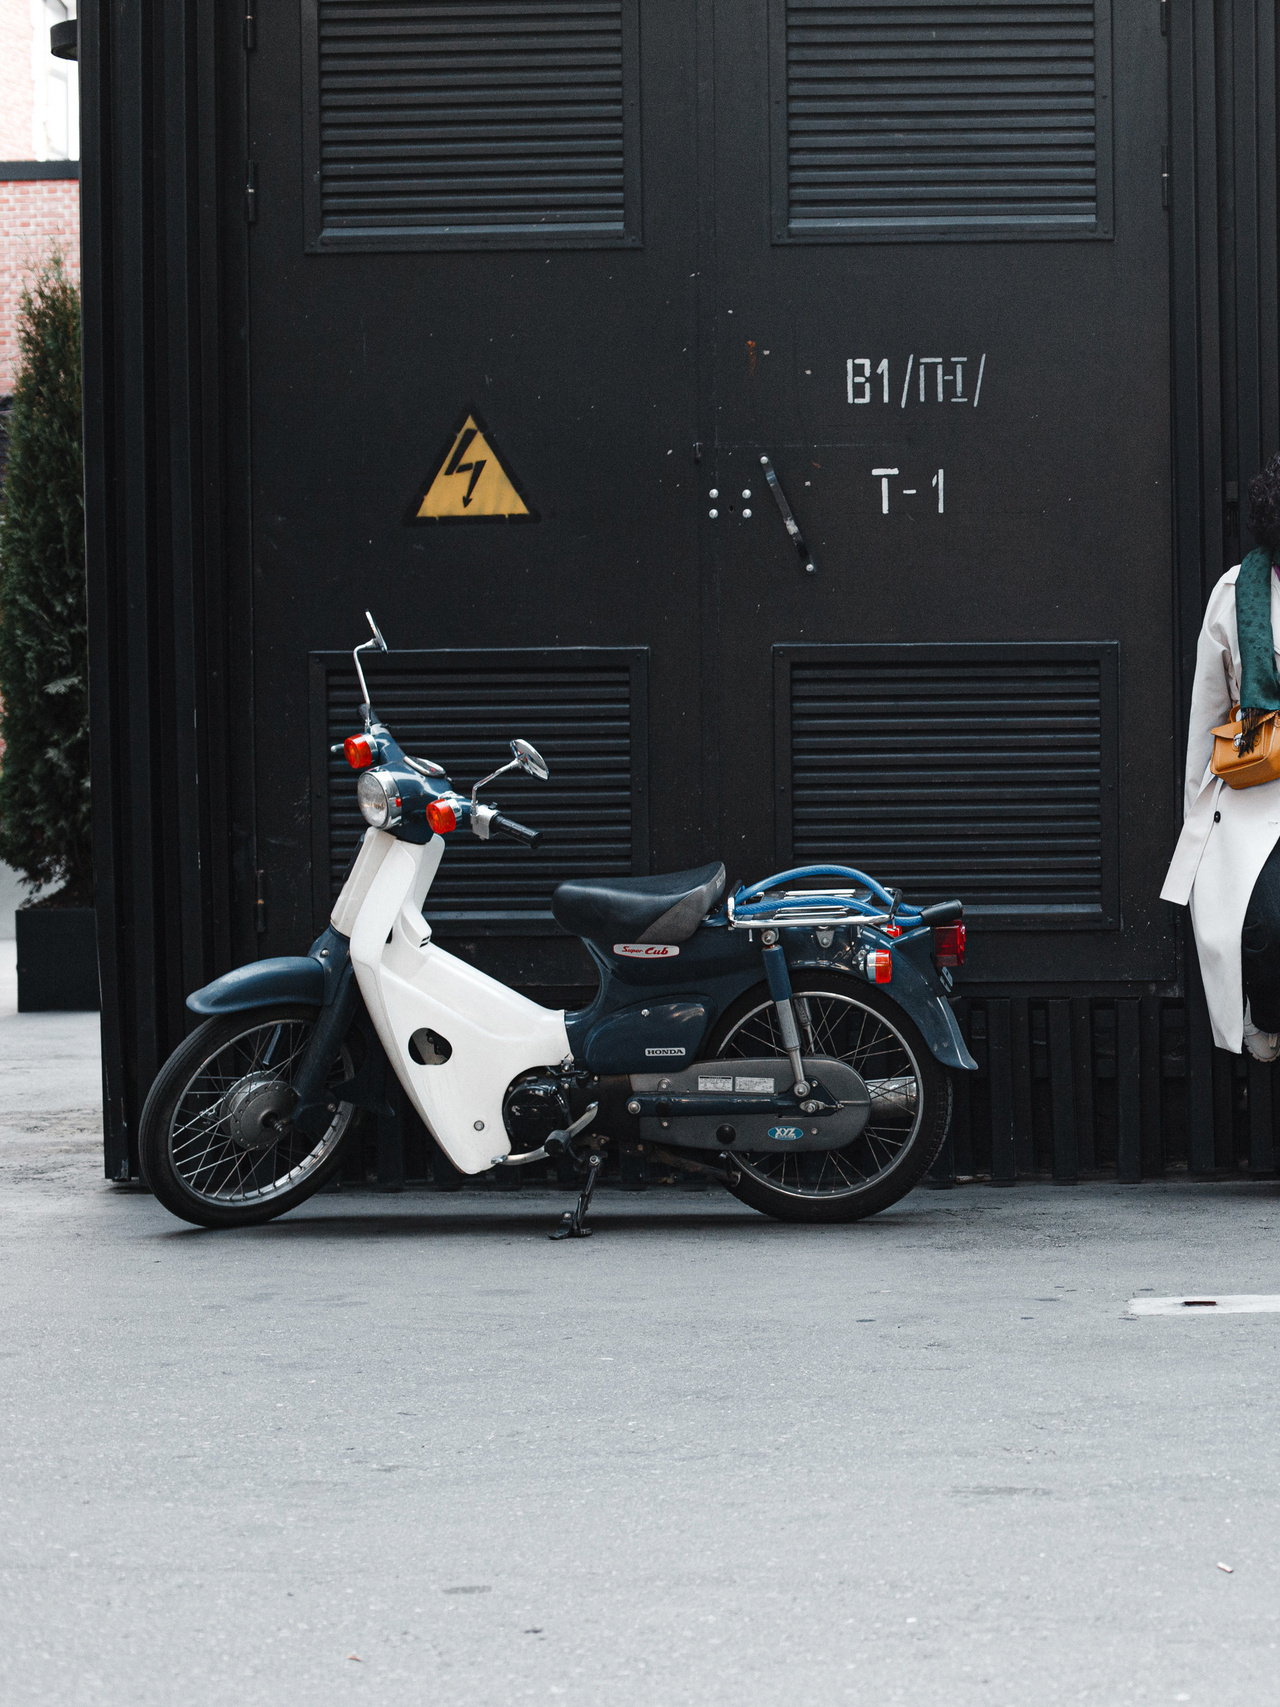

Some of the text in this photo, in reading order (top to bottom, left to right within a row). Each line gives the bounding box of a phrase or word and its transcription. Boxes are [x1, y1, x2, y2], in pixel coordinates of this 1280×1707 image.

[871, 467, 944, 514] Т-1
[622, 946, 669, 955] Super Cub
[775, 1127, 796, 1136] XYZ
